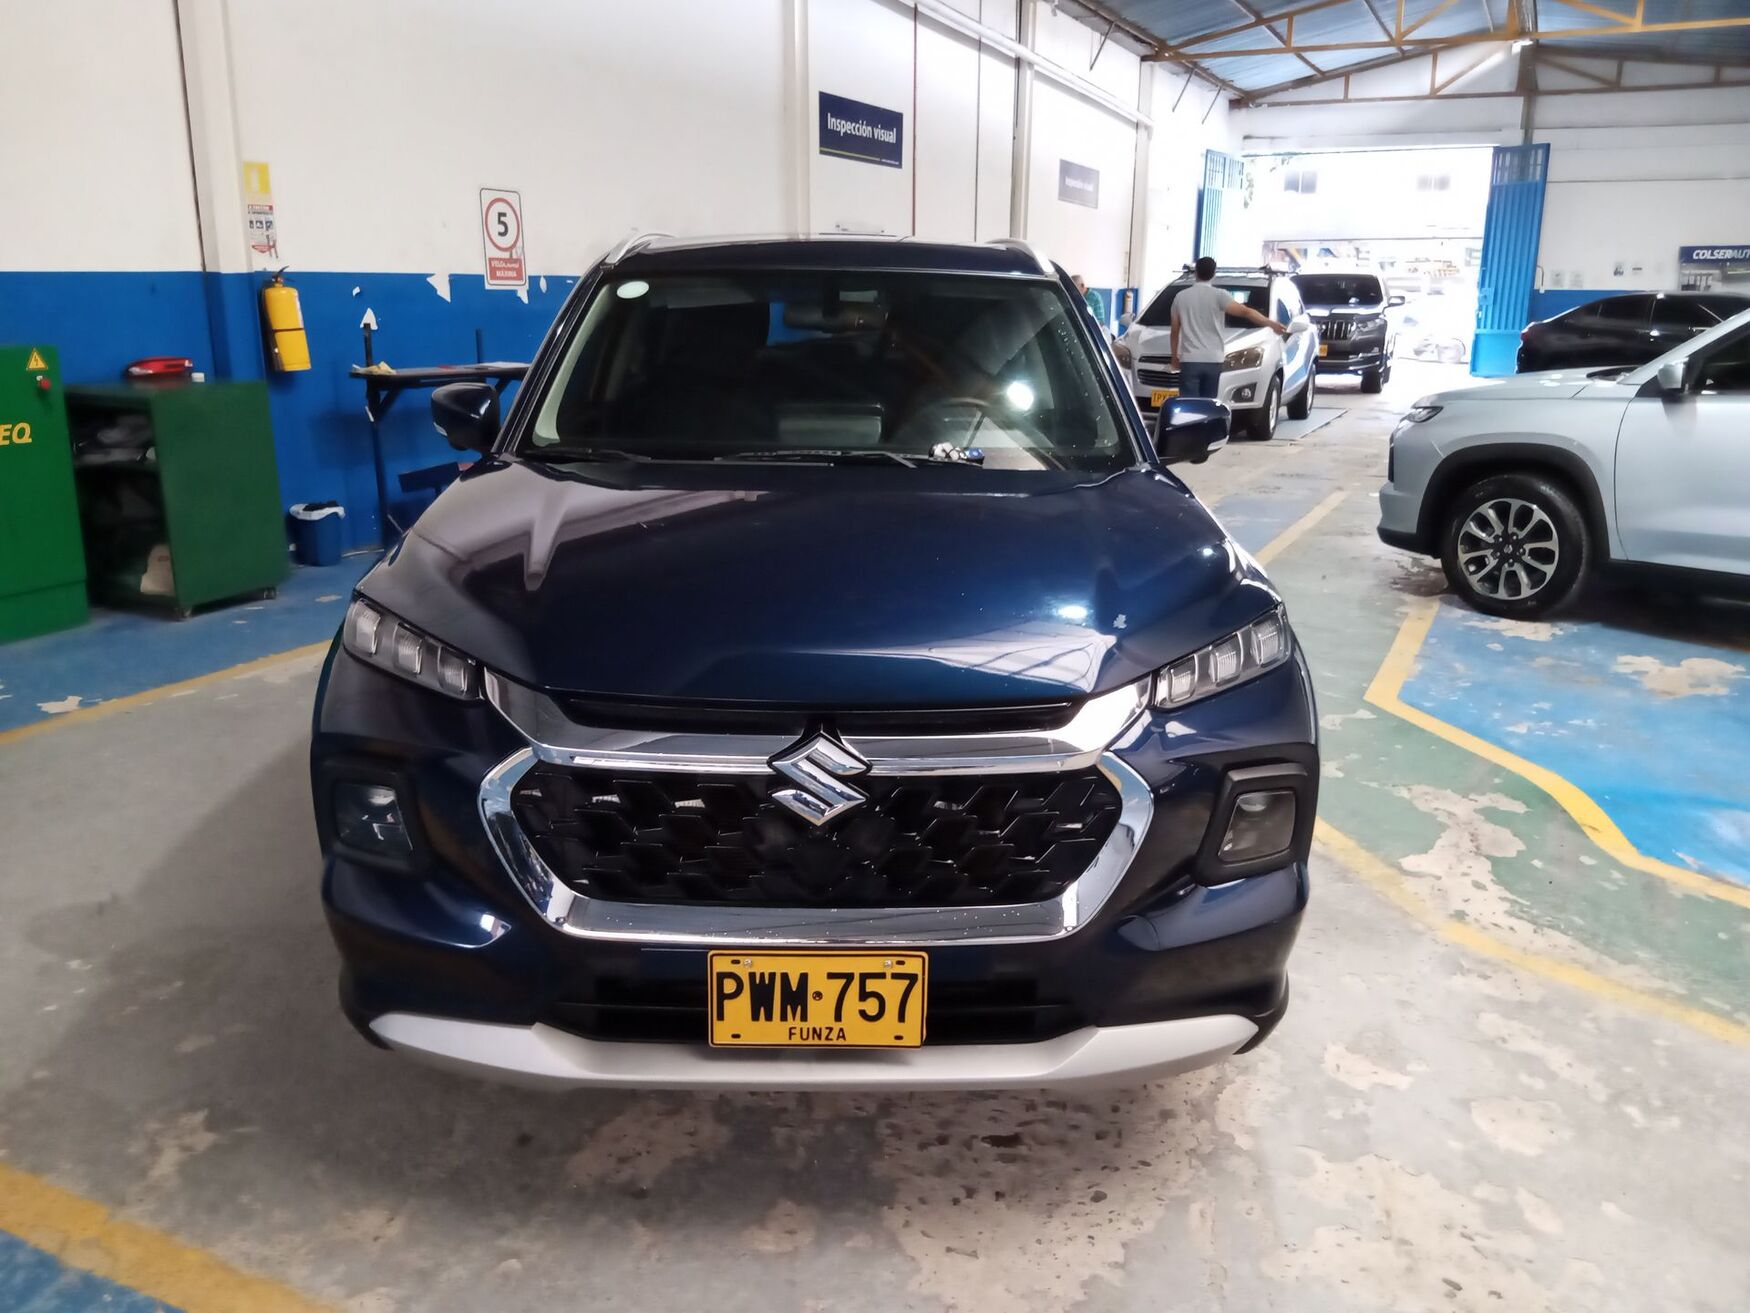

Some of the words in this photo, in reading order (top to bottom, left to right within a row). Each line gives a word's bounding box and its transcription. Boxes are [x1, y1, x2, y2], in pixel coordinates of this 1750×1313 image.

[827, 112, 872, 136] Inspección
[873, 124, 897, 143] visual
[497, 211, 509, 237] 5
[715, 971, 809, 1023] PWM
[826, 971, 919, 1024] 757
[788, 1026, 847, 1041] FUNZA
